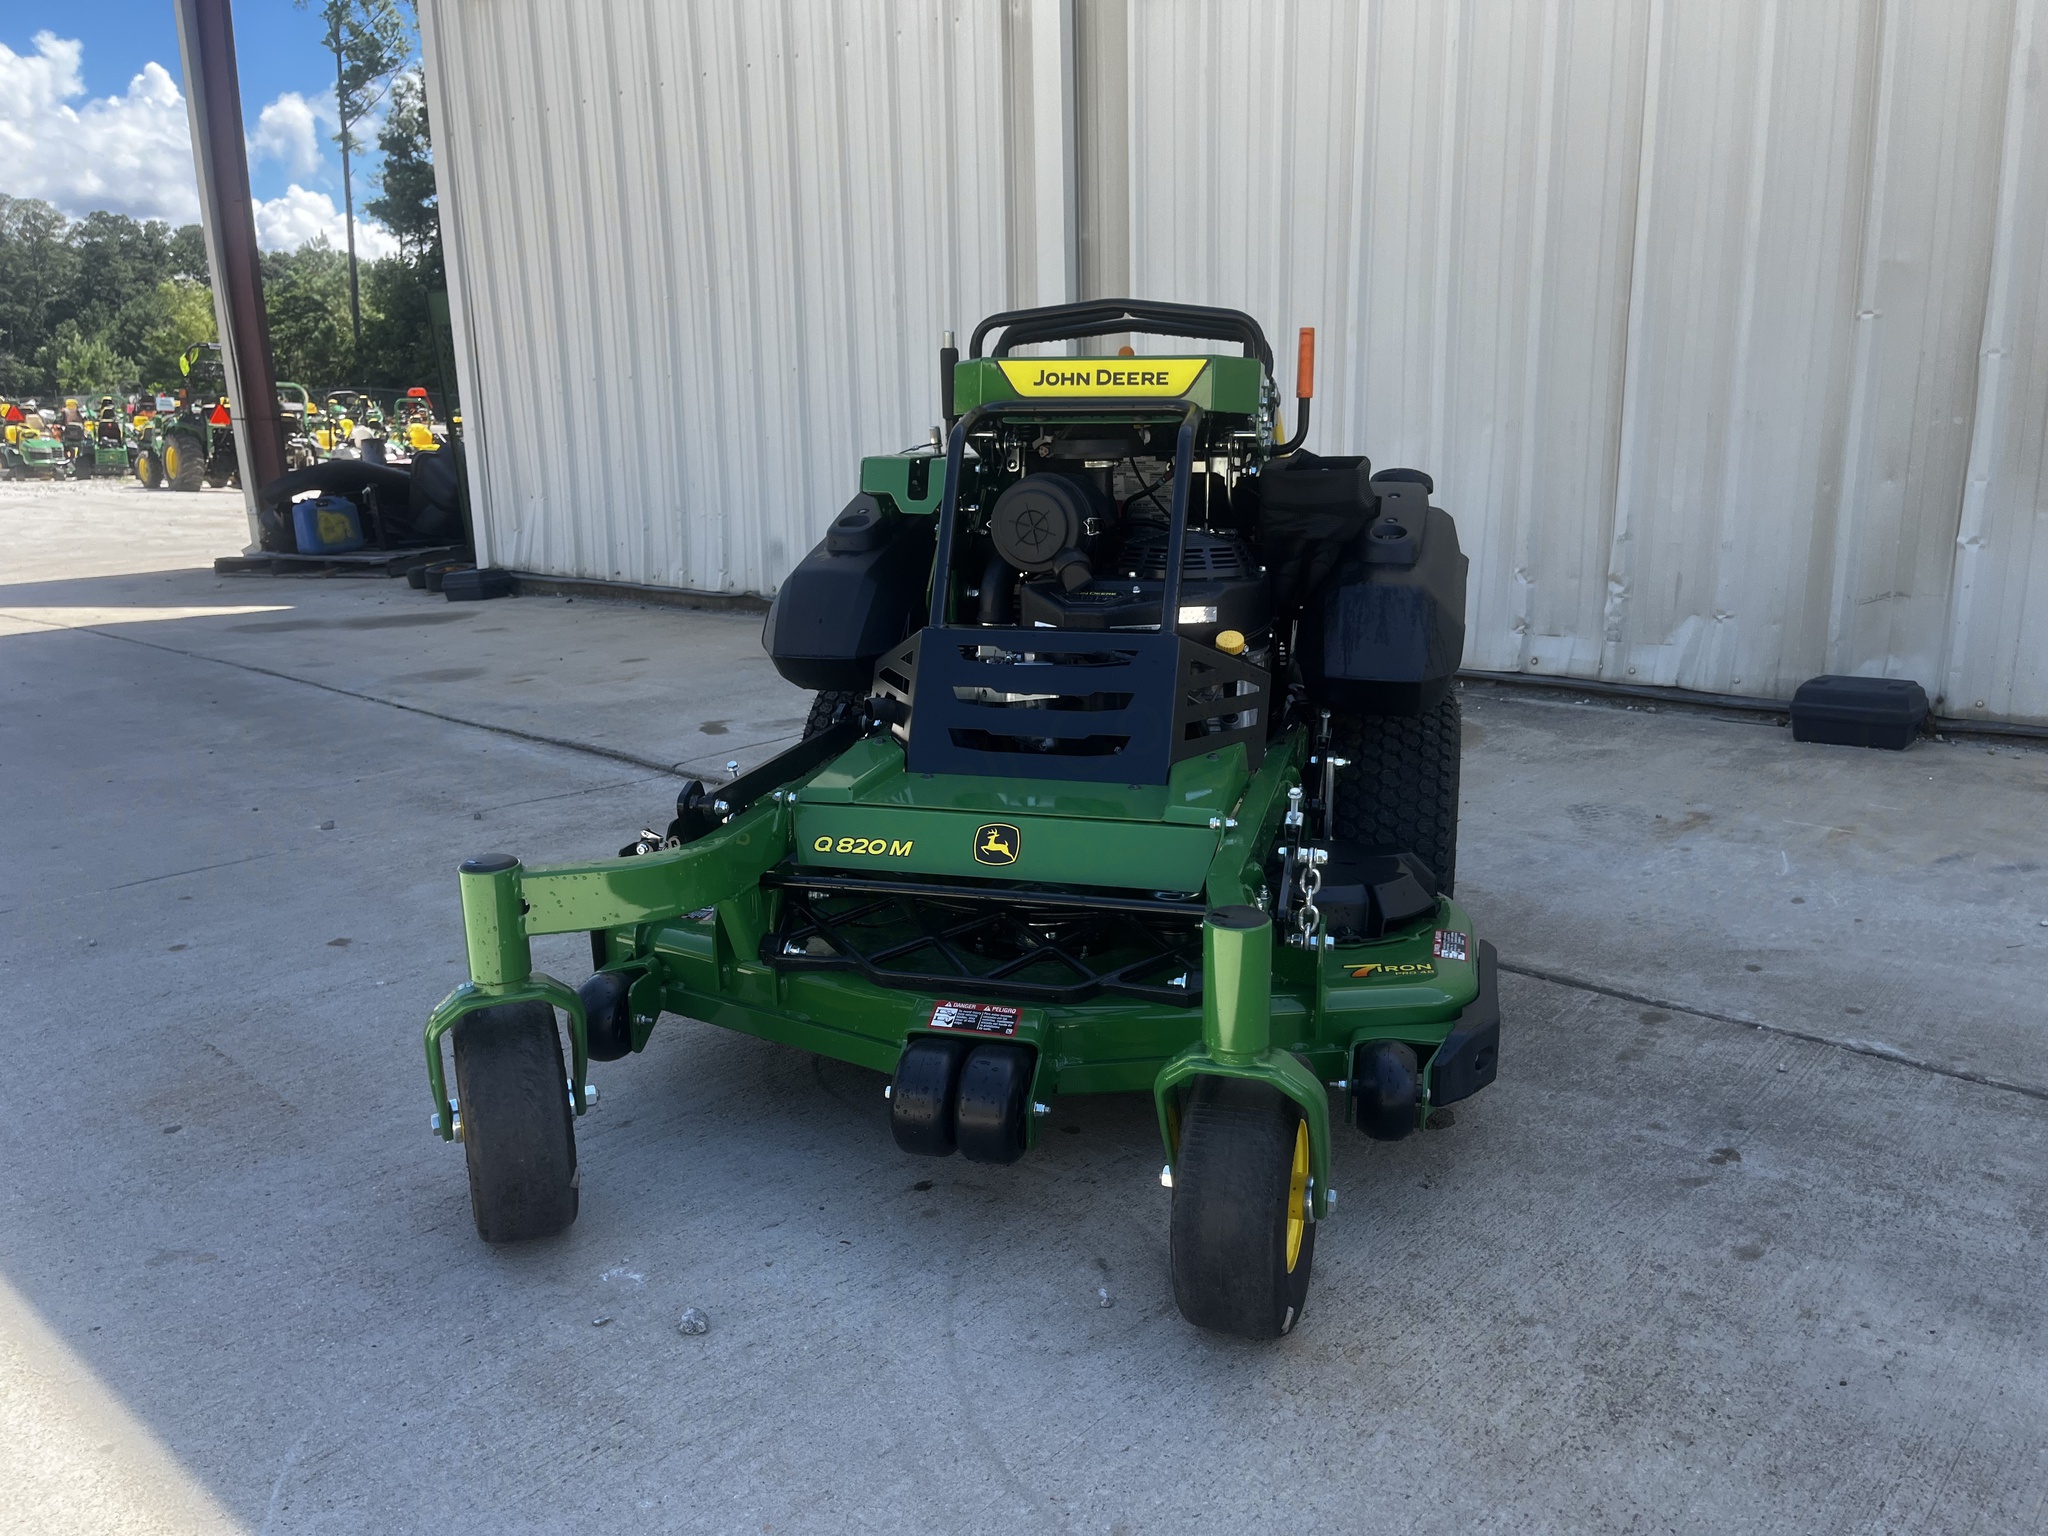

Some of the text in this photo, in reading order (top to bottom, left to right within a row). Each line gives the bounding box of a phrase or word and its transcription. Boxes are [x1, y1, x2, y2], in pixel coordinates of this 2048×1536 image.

[1033, 369, 1169, 387] JOHN DEERE
[814, 836, 914, 857] Q 820 M
[953, 1002, 1017, 1015] DANGER PELIGRO
